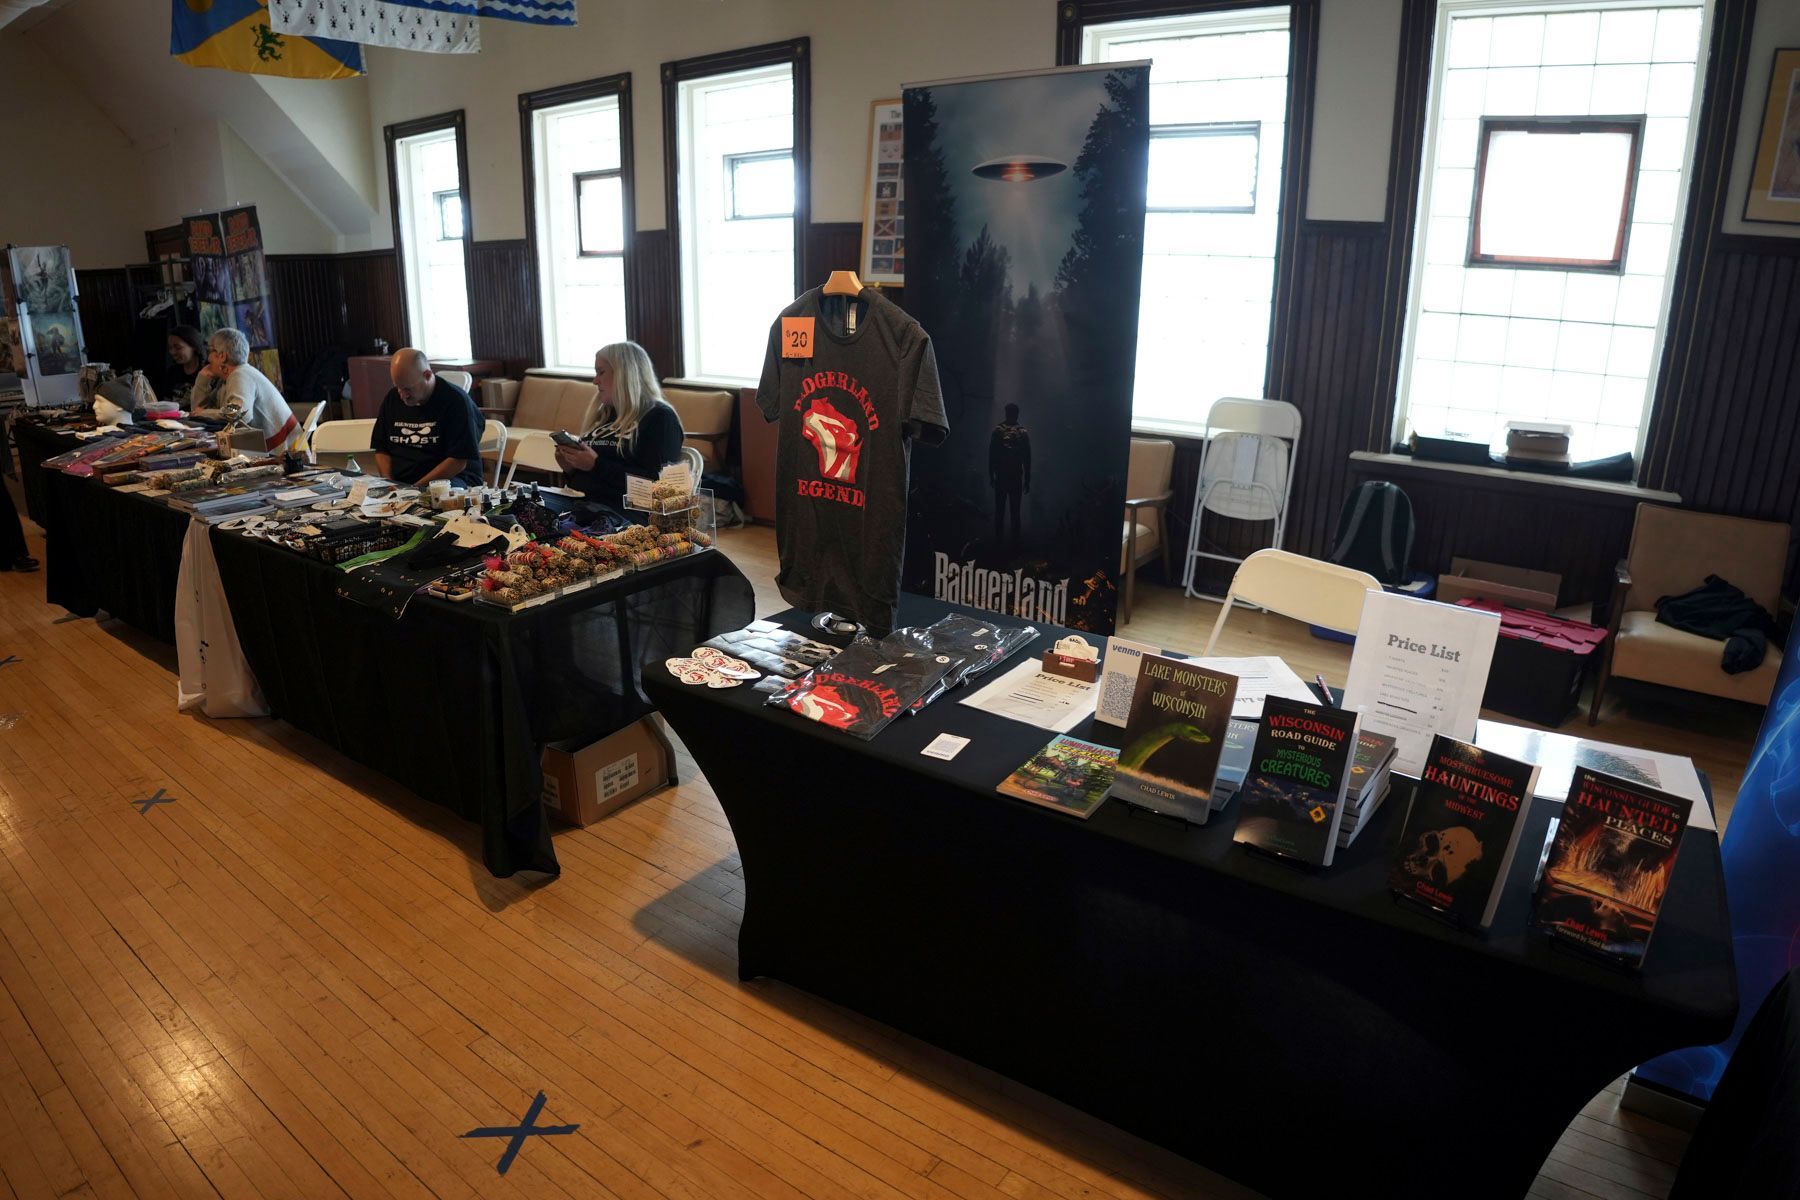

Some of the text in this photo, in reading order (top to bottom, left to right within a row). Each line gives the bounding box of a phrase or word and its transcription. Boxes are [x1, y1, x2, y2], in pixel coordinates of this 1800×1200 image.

[793, 371, 881, 431] DGERLAND
[796, 478, 866, 508] EGEND
[935, 552, 1070, 628] Badgerland
[1112, 644, 1141, 657] venmo
[1387, 634, 1461, 663] Price List
[1034, 673, 1091, 691] Price List
[1144, 661, 1230, 698] LAKE MONSTERS
[1152, 692, 1207, 720] WISCONSIN
[1228, 721, 1256, 732] STERS
[1269, 714, 1345, 742] WISCONSIN
[1270, 729, 1336, 751] ROAD GUIDE
[1276, 748, 1322, 768] MYSTERIOUS
[1440, 756, 1514, 787] MOST GRUESOME
[1260, 758, 1331, 788] CREATURES
[1583, 774, 1596, 783] the
[1140, 784, 1176, 800] CHAD LEWIS
[1425, 765, 1520, 811] HAUNTINGS
[1445, 800, 1486, 821] MIDWEST
[1577, 791, 1678, 834] HAUNTED
[1671, 812, 1681, 820] to
[1605, 816, 1673, 846] PLACES
